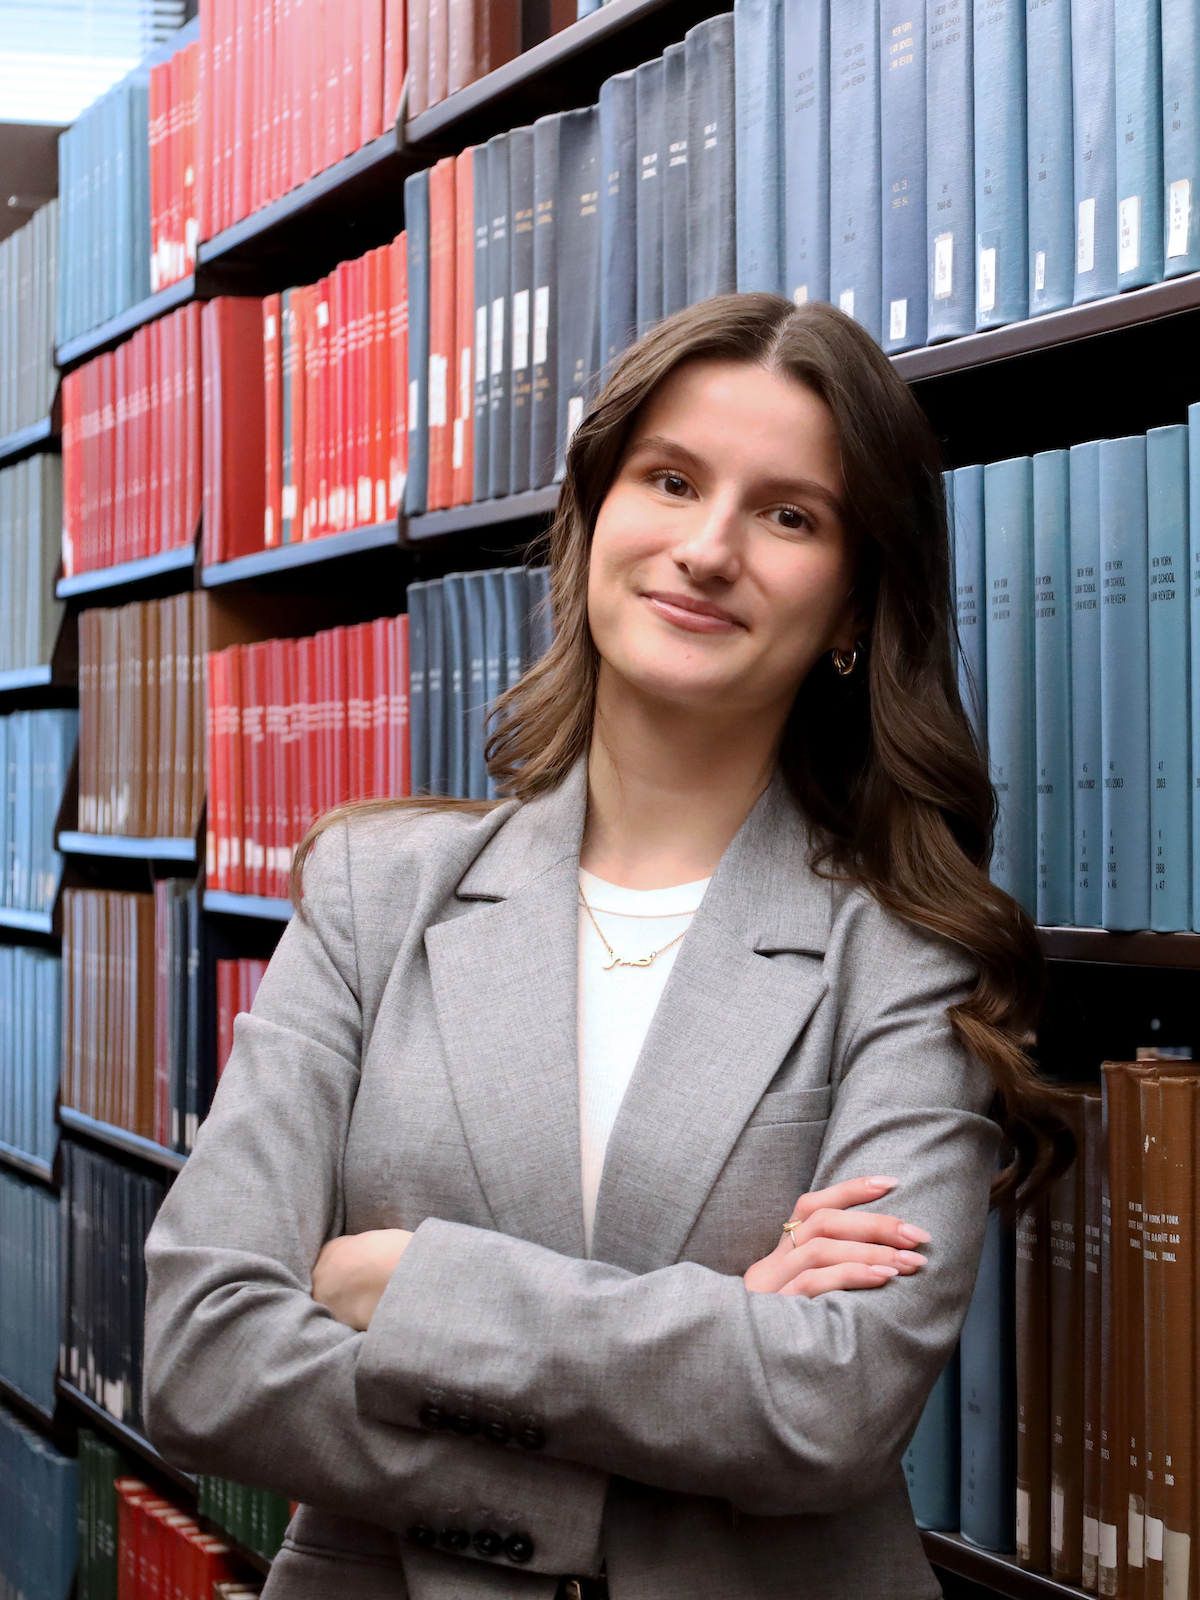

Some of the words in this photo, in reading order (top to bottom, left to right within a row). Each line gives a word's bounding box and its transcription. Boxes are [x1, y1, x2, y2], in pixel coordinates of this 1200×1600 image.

[1158, 573, 1175, 583] SCHOOL
[1158, 590, 1175, 600] REVIEW
[1167, 1215, 1179, 1225] YORK
[1051, 1220, 1061, 1231] NEW
[1062, 1223, 1074, 1234] YORK
[1169, 1234, 1180, 1244] BAR
[1050, 1238, 1064, 1250] STATE
[1065, 1241, 1076, 1252] BAR
[1053, 1256, 1072, 1270] JOURNAL
